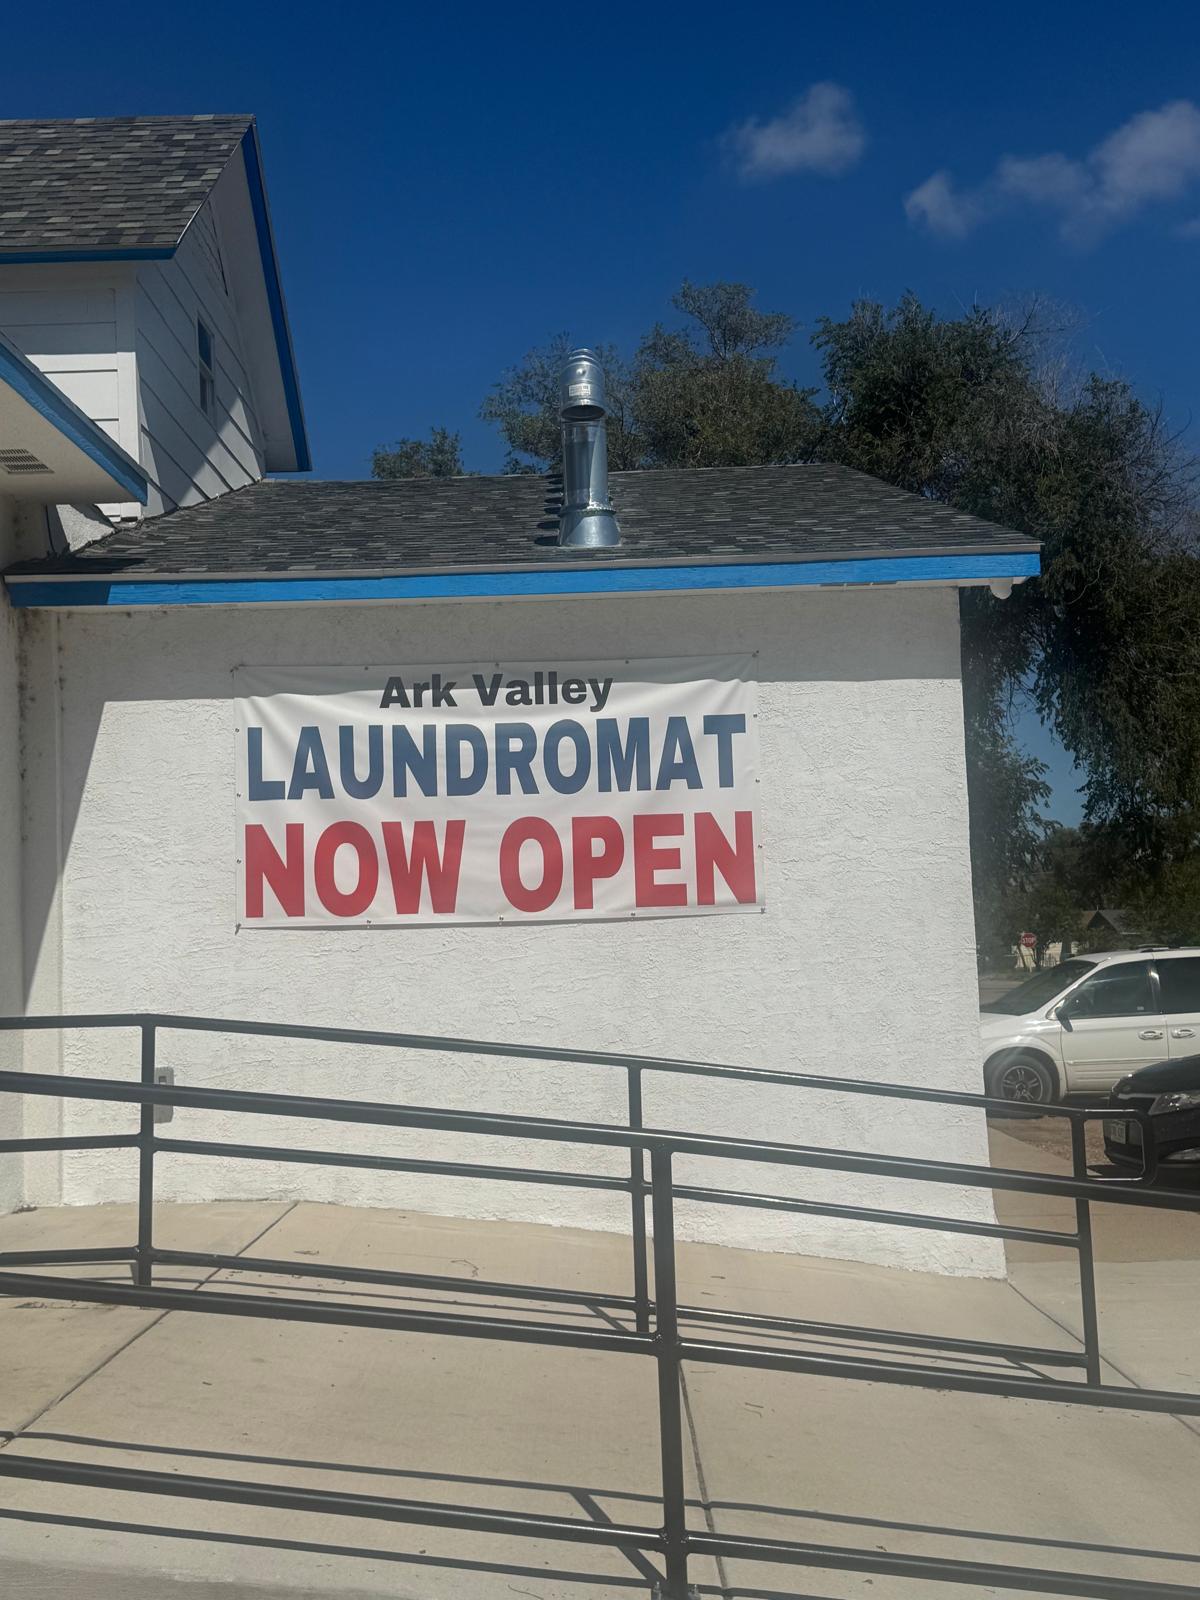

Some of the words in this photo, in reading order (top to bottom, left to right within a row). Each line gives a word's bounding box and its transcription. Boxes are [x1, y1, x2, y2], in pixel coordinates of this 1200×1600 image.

[379, 674, 458, 709] Ark
[472, 671, 614, 713] Valley
[247, 713, 746, 802] LAUNDROMAT
[245, 819, 466, 918] NOW
[500, 811, 757, 913] OPEN
